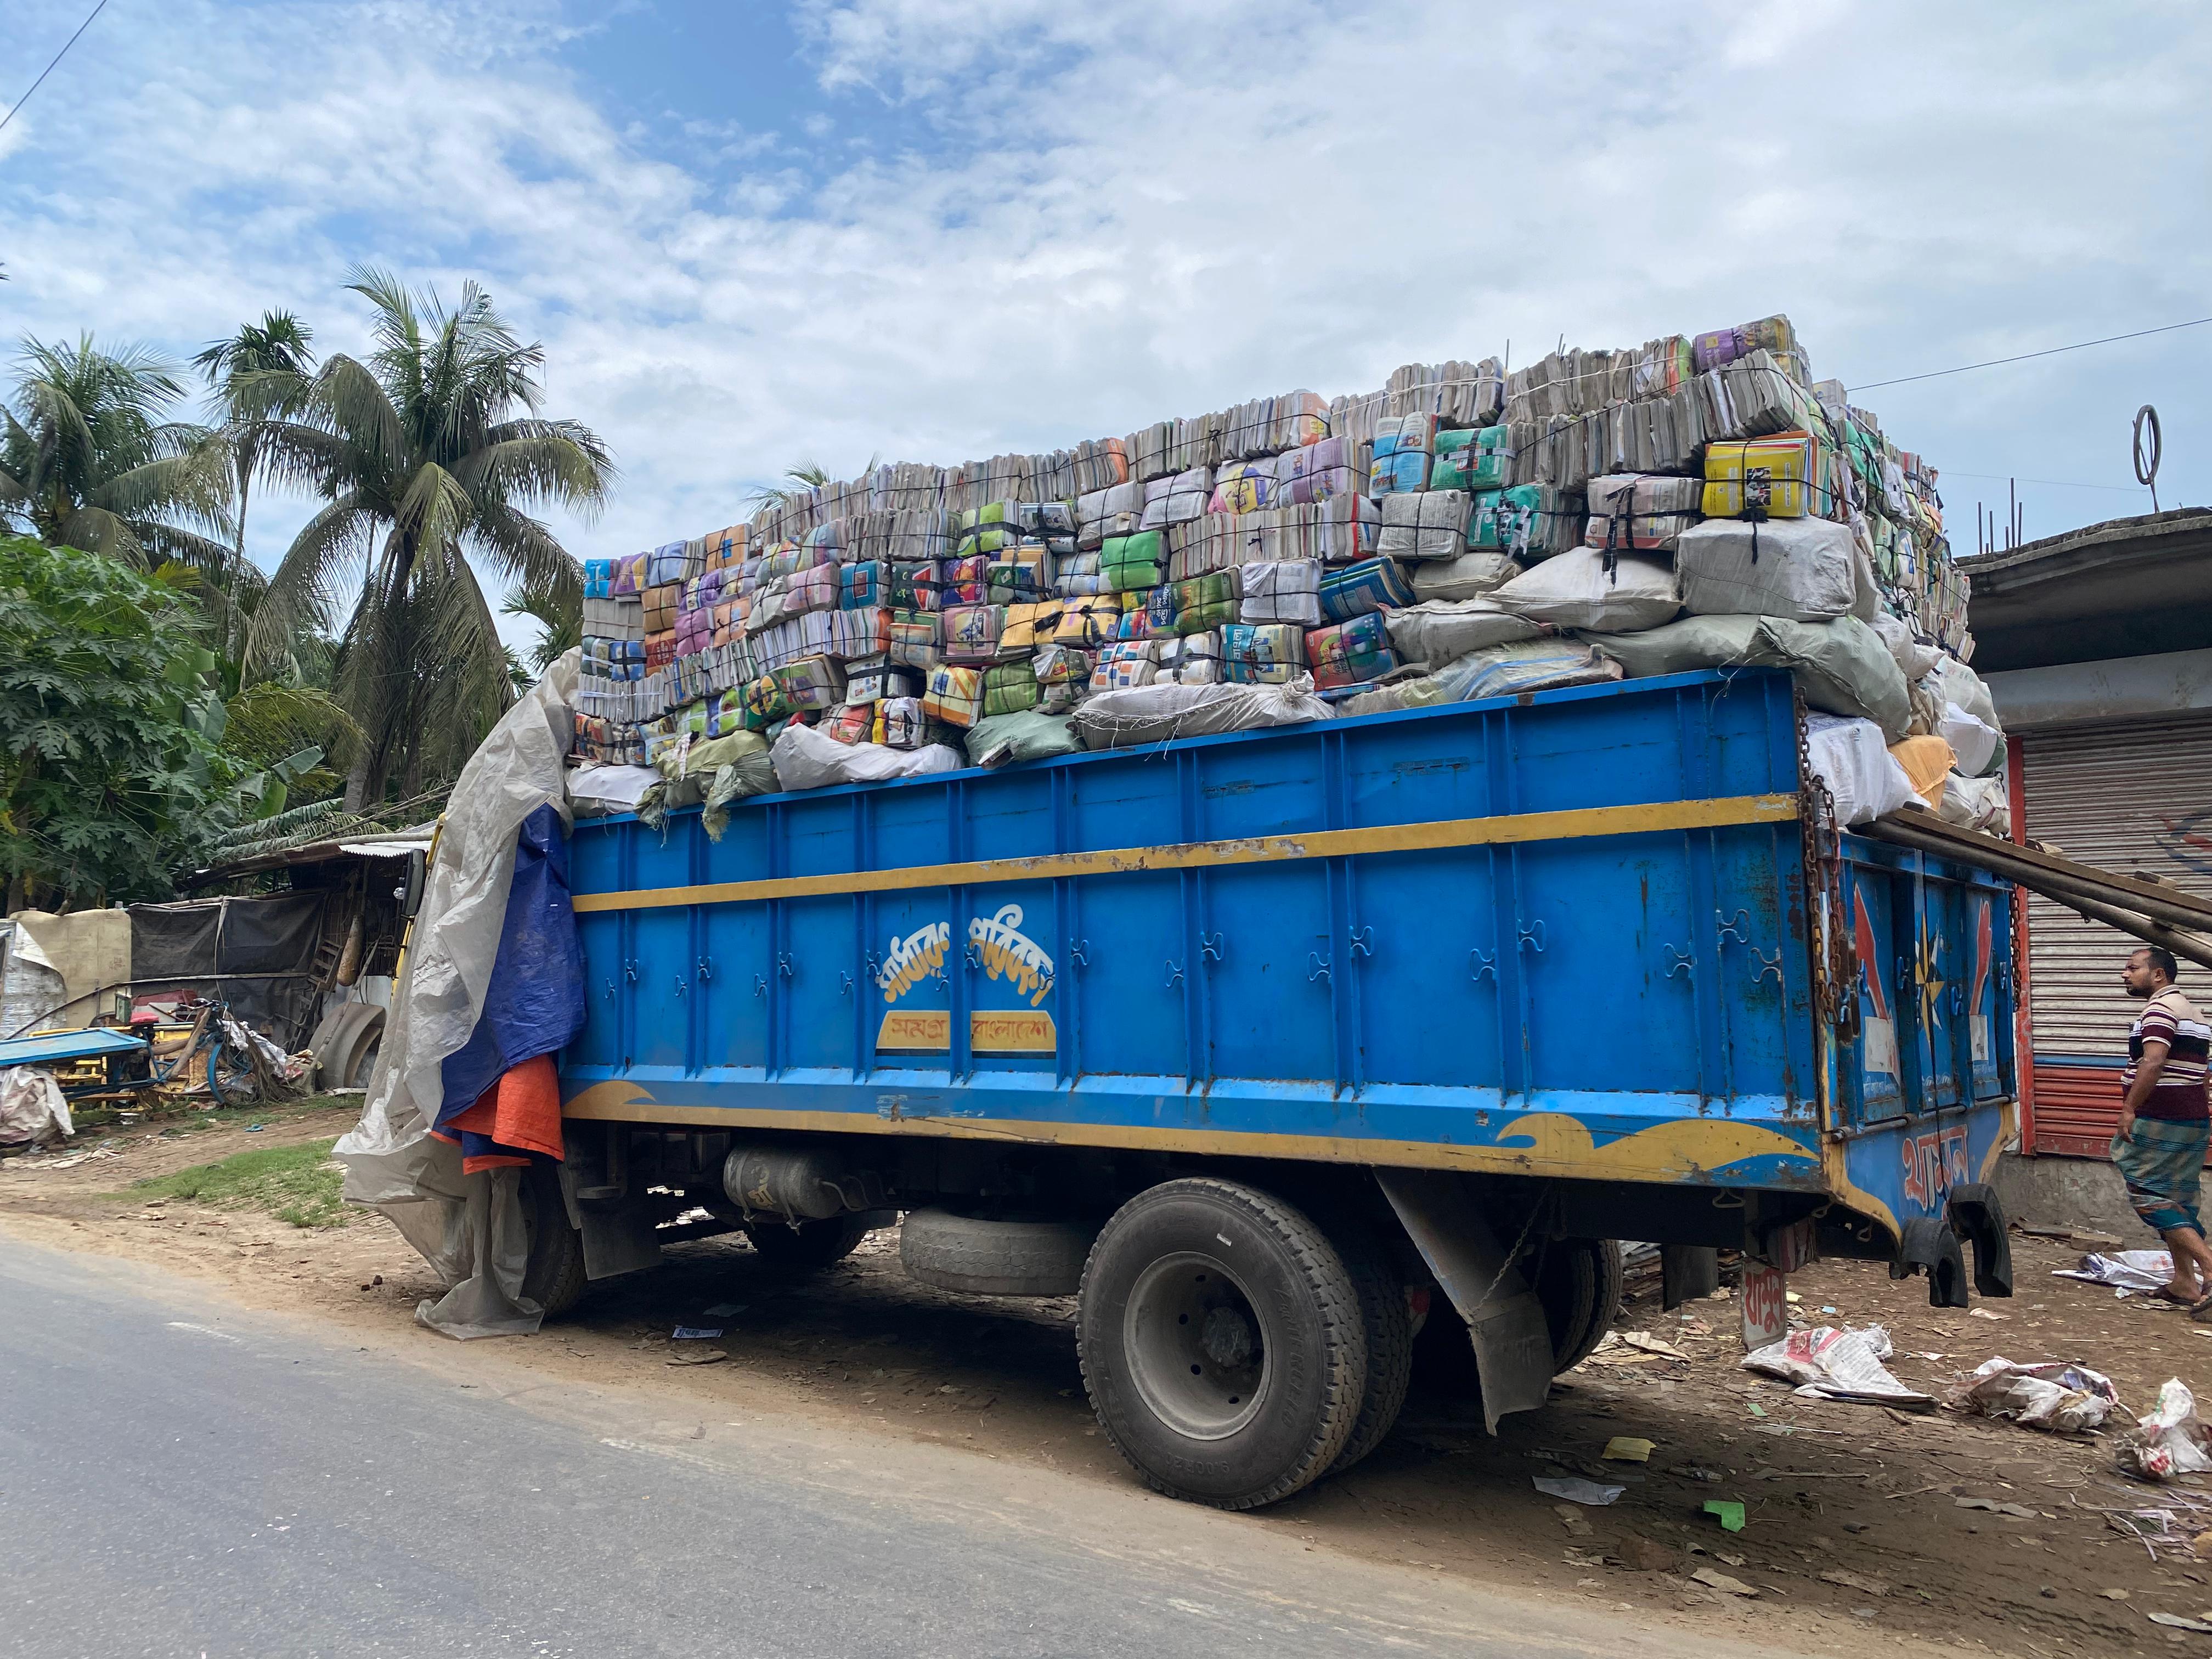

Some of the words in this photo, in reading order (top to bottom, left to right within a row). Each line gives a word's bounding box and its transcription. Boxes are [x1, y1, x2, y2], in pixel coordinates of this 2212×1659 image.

[1233, 628, 1243, 660] বাংলা
[968, 904, 1054, 1007] পরিবহন
[891, 1018, 947, 1039] সমগ্র
[972, 1020, 1048, 1039] বাংলাদেশ
[1902, 1124, 1969, 1220] থামন
[1745, 1266, 1784, 1333] থামুন
